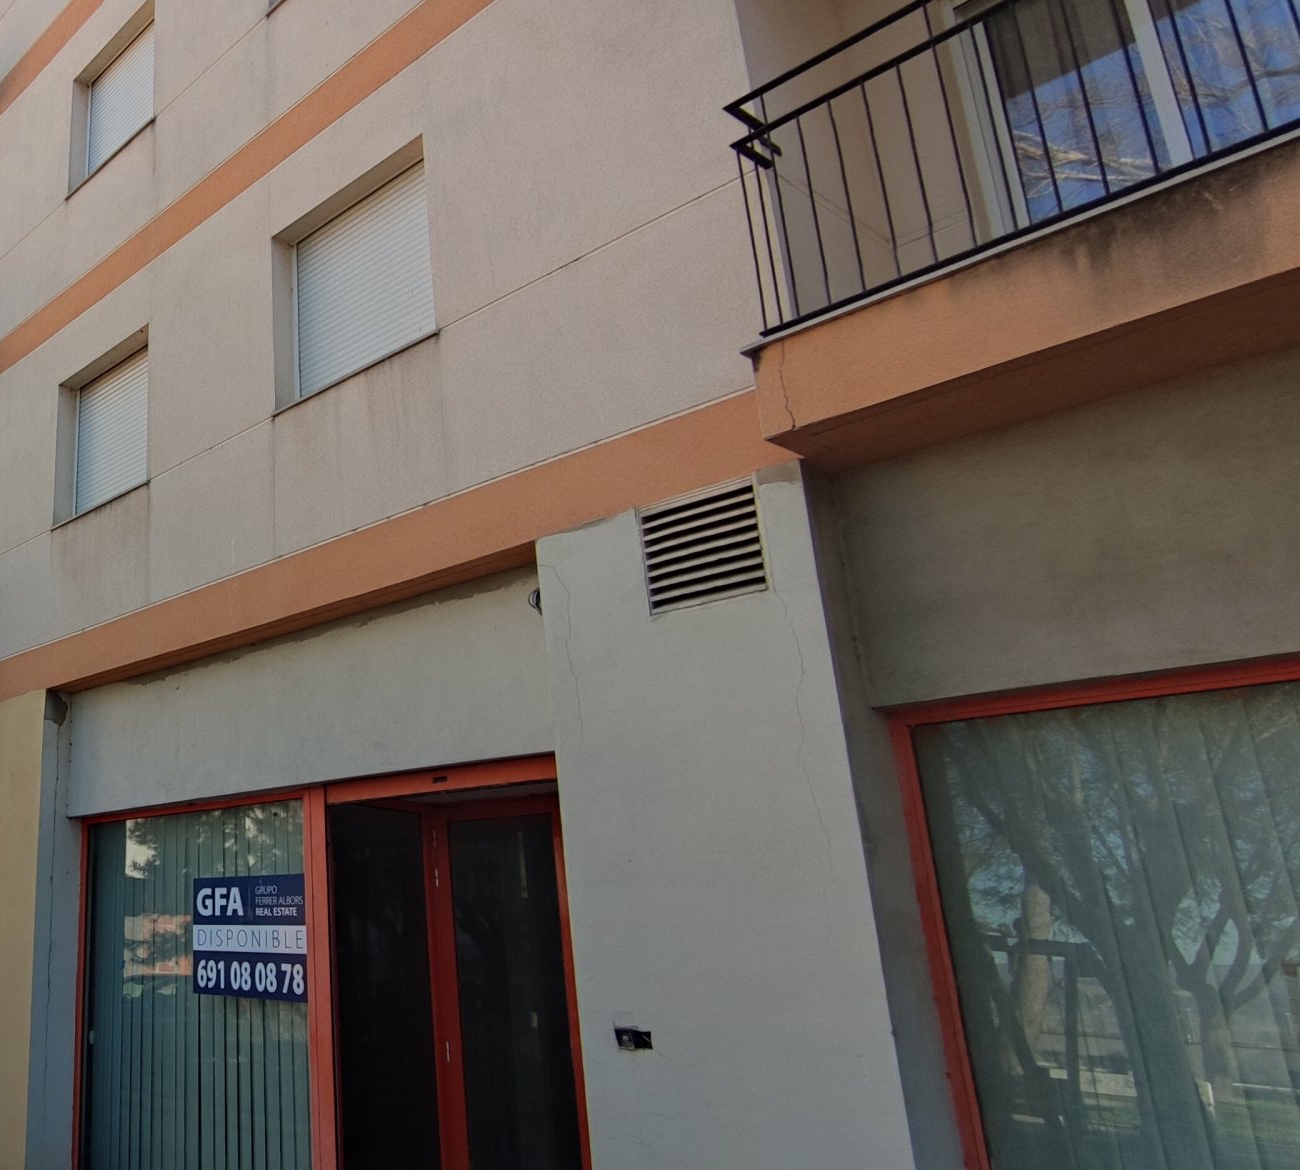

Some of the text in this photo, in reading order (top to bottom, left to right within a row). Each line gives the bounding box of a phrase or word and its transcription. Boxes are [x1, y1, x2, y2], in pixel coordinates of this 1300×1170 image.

[255, 885, 278, 895] GRUPO
[196, 887, 244, 917] GFA
[255, 895, 304, 906] FERRER ALBORS
[255, 907, 298, 916] REAL ESTATE
[197, 928, 304, 949] DISPONIBLE
[197, 959, 305, 995] 691 08 08 78
